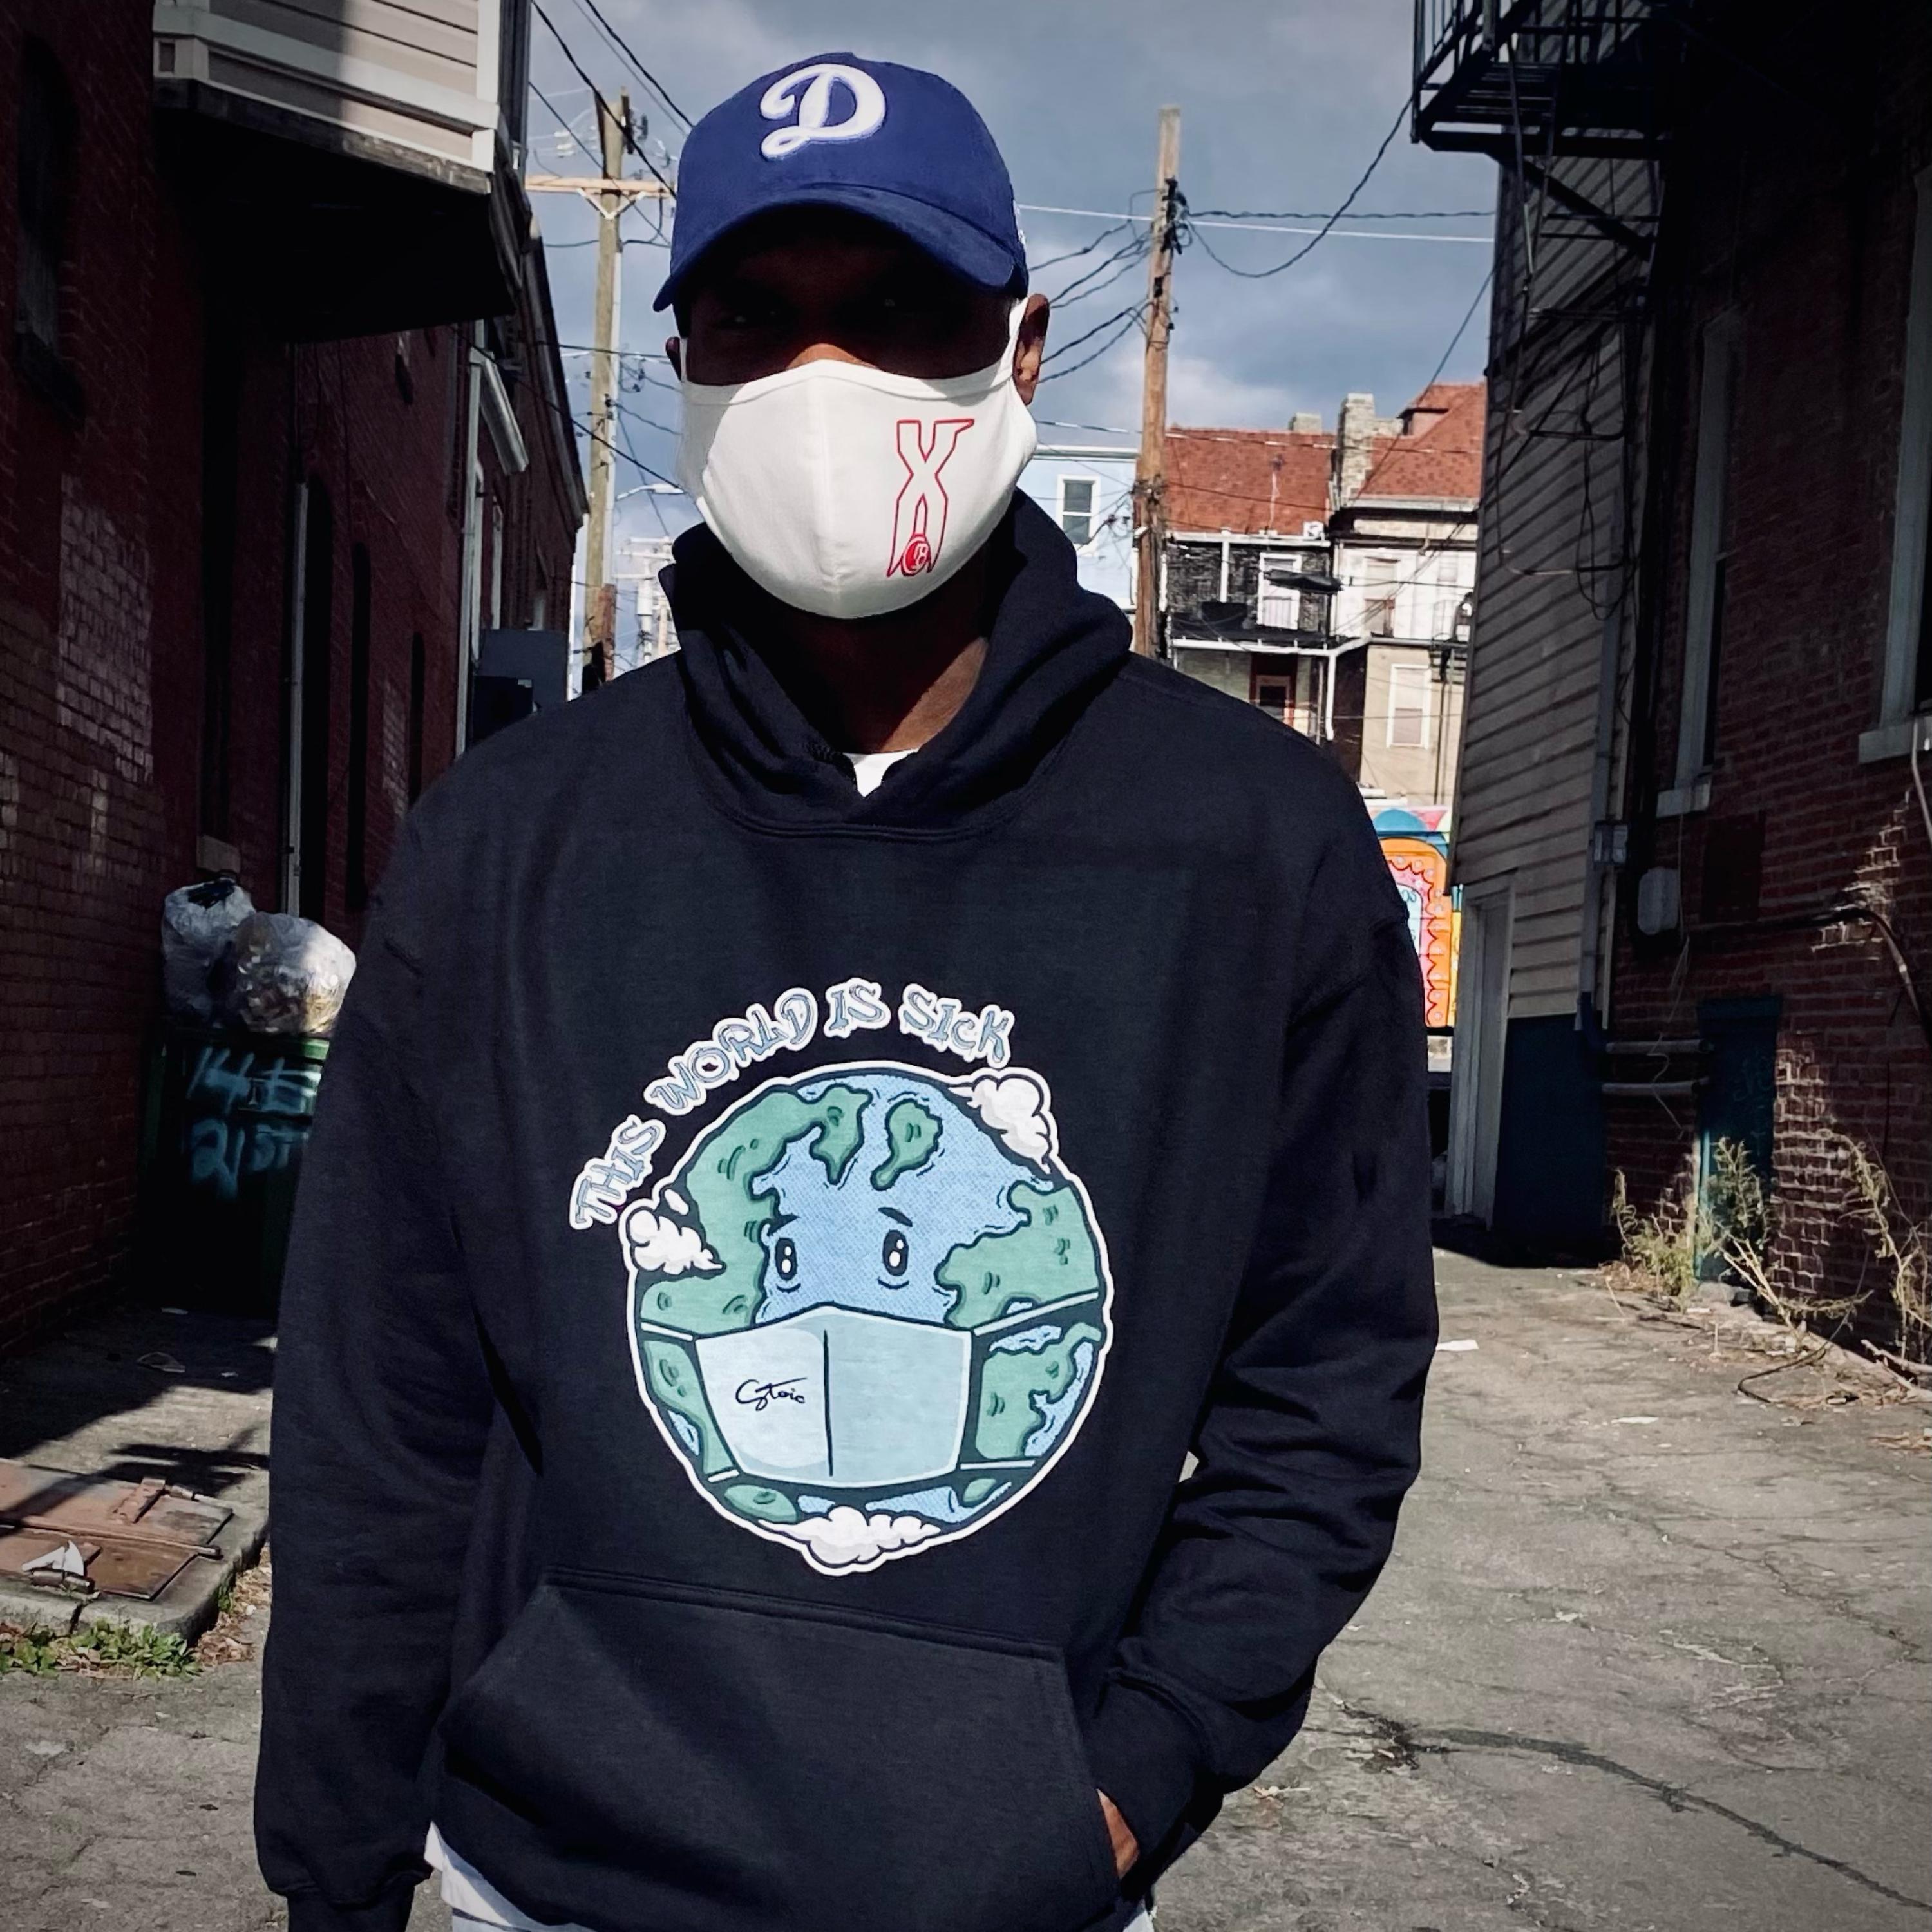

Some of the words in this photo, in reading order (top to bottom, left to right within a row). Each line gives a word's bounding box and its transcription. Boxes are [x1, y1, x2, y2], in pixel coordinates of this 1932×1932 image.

[759, 62, 887, 161] D
[572, 1117, 663, 1226] THIS
[647, 990, 815, 1113] WORLD
[826, 981, 889, 1035] IS
[901, 985, 1012, 1065] SICK
